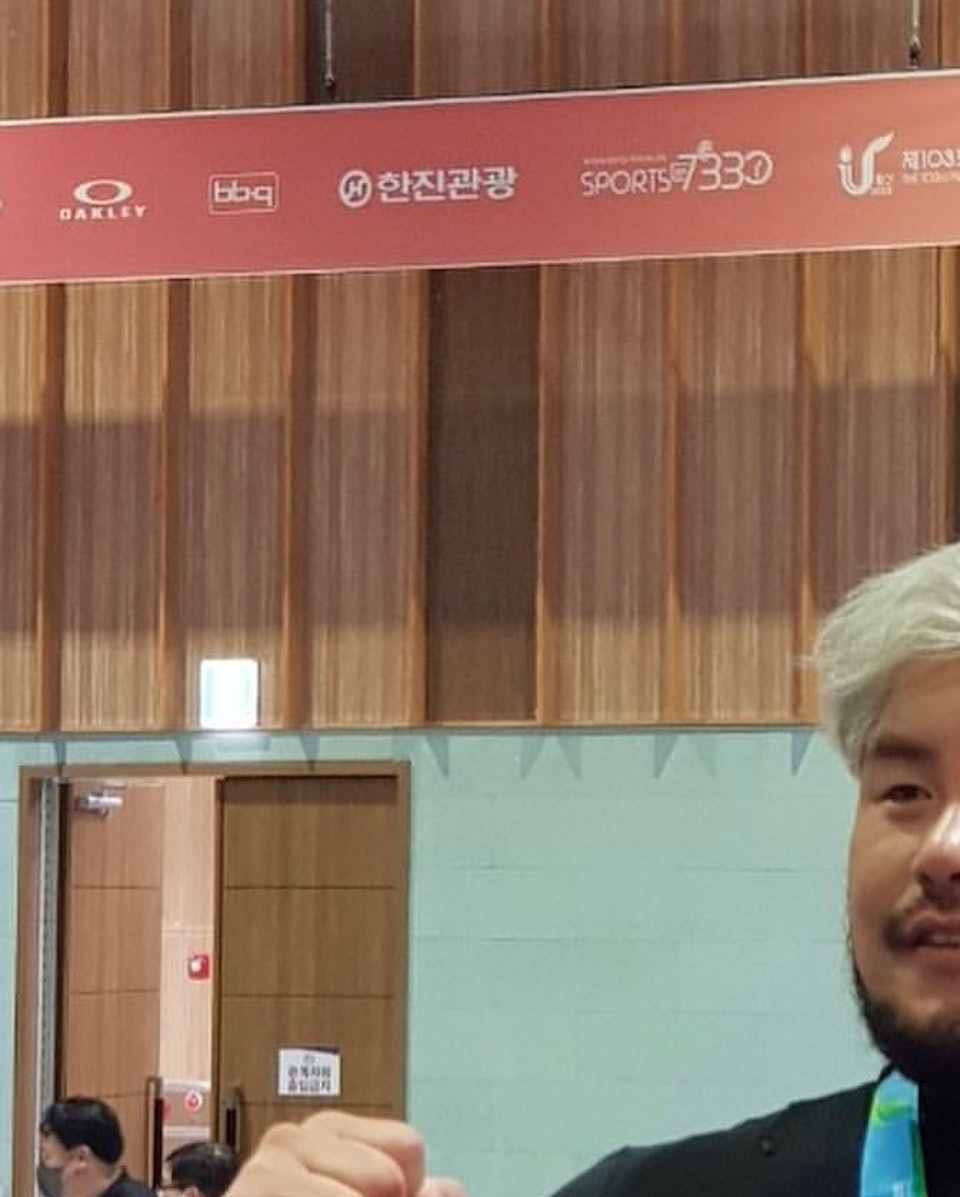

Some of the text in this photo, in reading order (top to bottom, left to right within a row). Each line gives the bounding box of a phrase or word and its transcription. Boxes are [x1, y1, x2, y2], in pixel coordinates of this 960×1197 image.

[377, 165, 518, 204] 한진관광
[580, 168, 673, 197] SPORTS
[59, 204, 147, 221] OAKLEY
